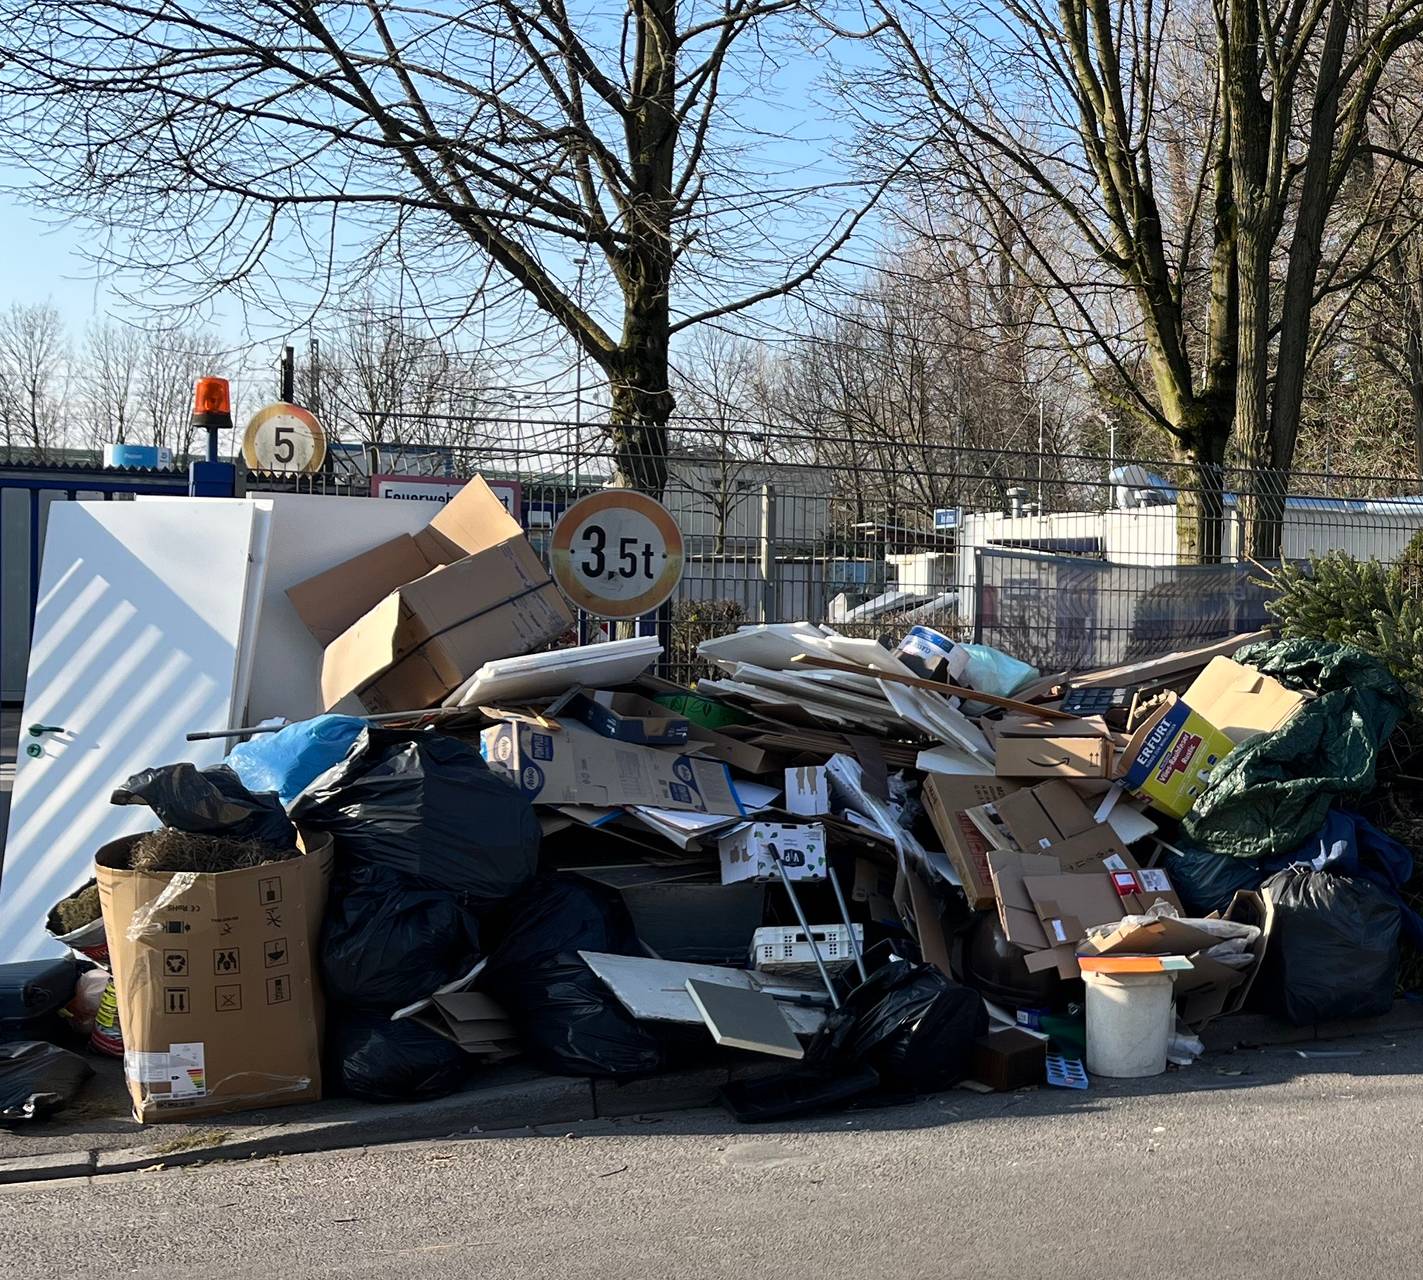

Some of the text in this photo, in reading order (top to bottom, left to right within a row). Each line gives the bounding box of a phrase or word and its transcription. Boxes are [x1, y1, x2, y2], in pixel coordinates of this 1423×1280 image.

[274, 427, 294, 463] 5
[581, 525, 655, 581] 3,5t
[1137, 717, 1172, 766] ERFURT
[1182, 744, 1196, 765] Rustic
